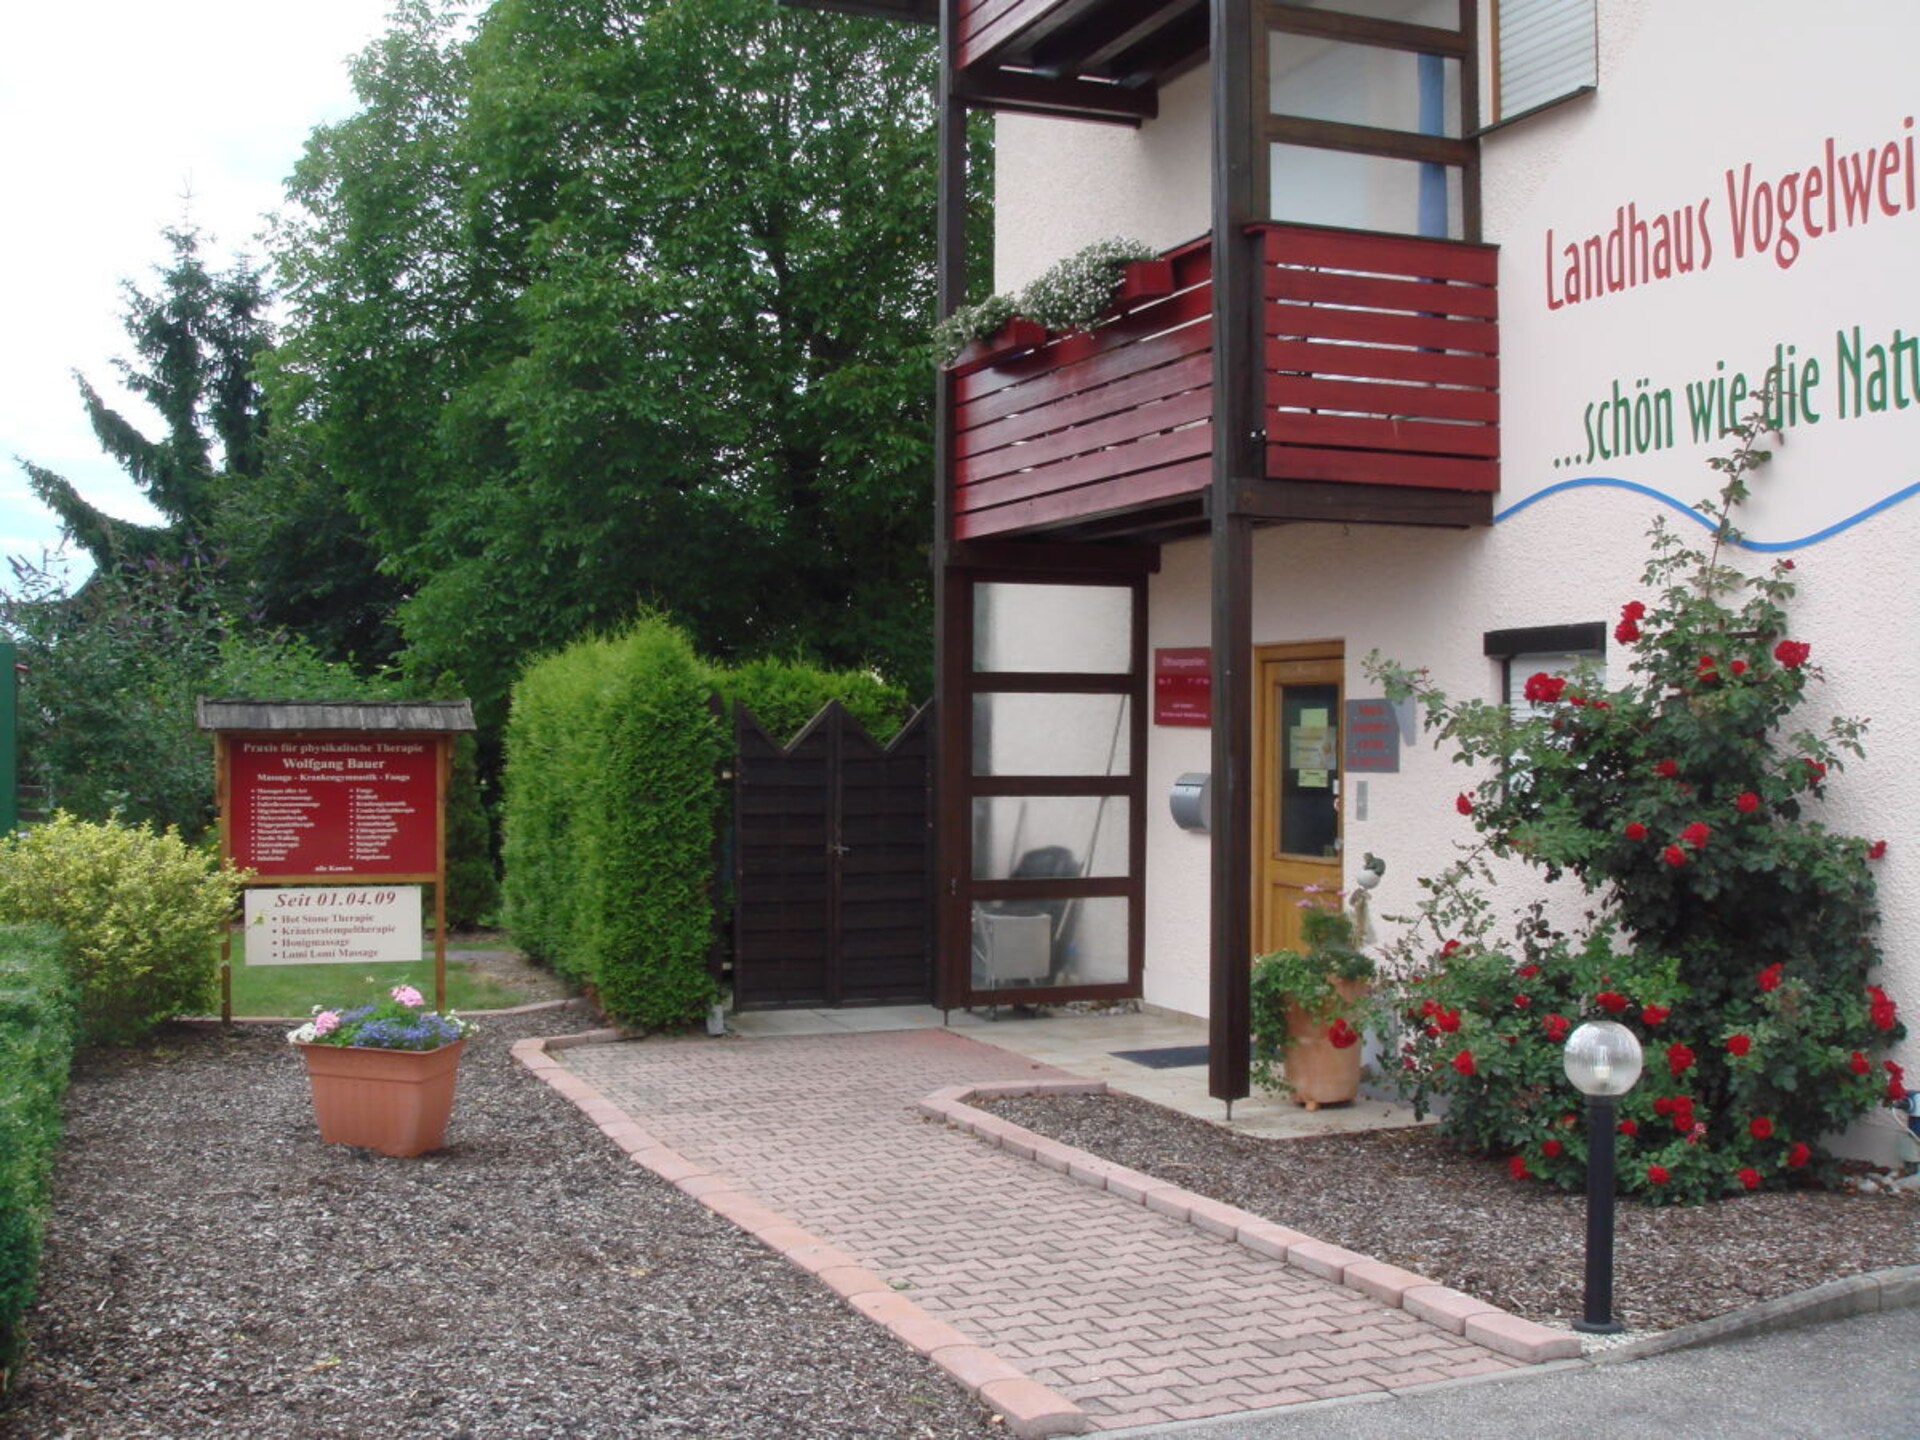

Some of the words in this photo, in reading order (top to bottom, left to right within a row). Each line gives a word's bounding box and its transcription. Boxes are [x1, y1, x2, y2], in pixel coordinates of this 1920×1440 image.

[1546, 198, 1712, 310] Landhaus
[1725, 116, 1916, 269] Vogelwei
[1553, 378, 1674, 468] ...schön
[1685, 360, 1747, 444] wie
[1762, 343, 1820, 429] die
[243, 743, 278, 753] Praxis
[281, 743, 298, 753] für
[300, 743, 372, 754] physikalische
[377, 743, 423, 754] Therapie
[282, 758, 344, 771] Wolfgang
[348, 758, 385, 769] Bauer
[275, 894, 312, 907] Seit
[317, 891, 396, 907] 01.04.09
[282, 914, 300, 924] Hot
[302, 914, 329, 923] Stone
[333, 913, 375, 924] Therapie
[338, 947, 379, 958] Massage
